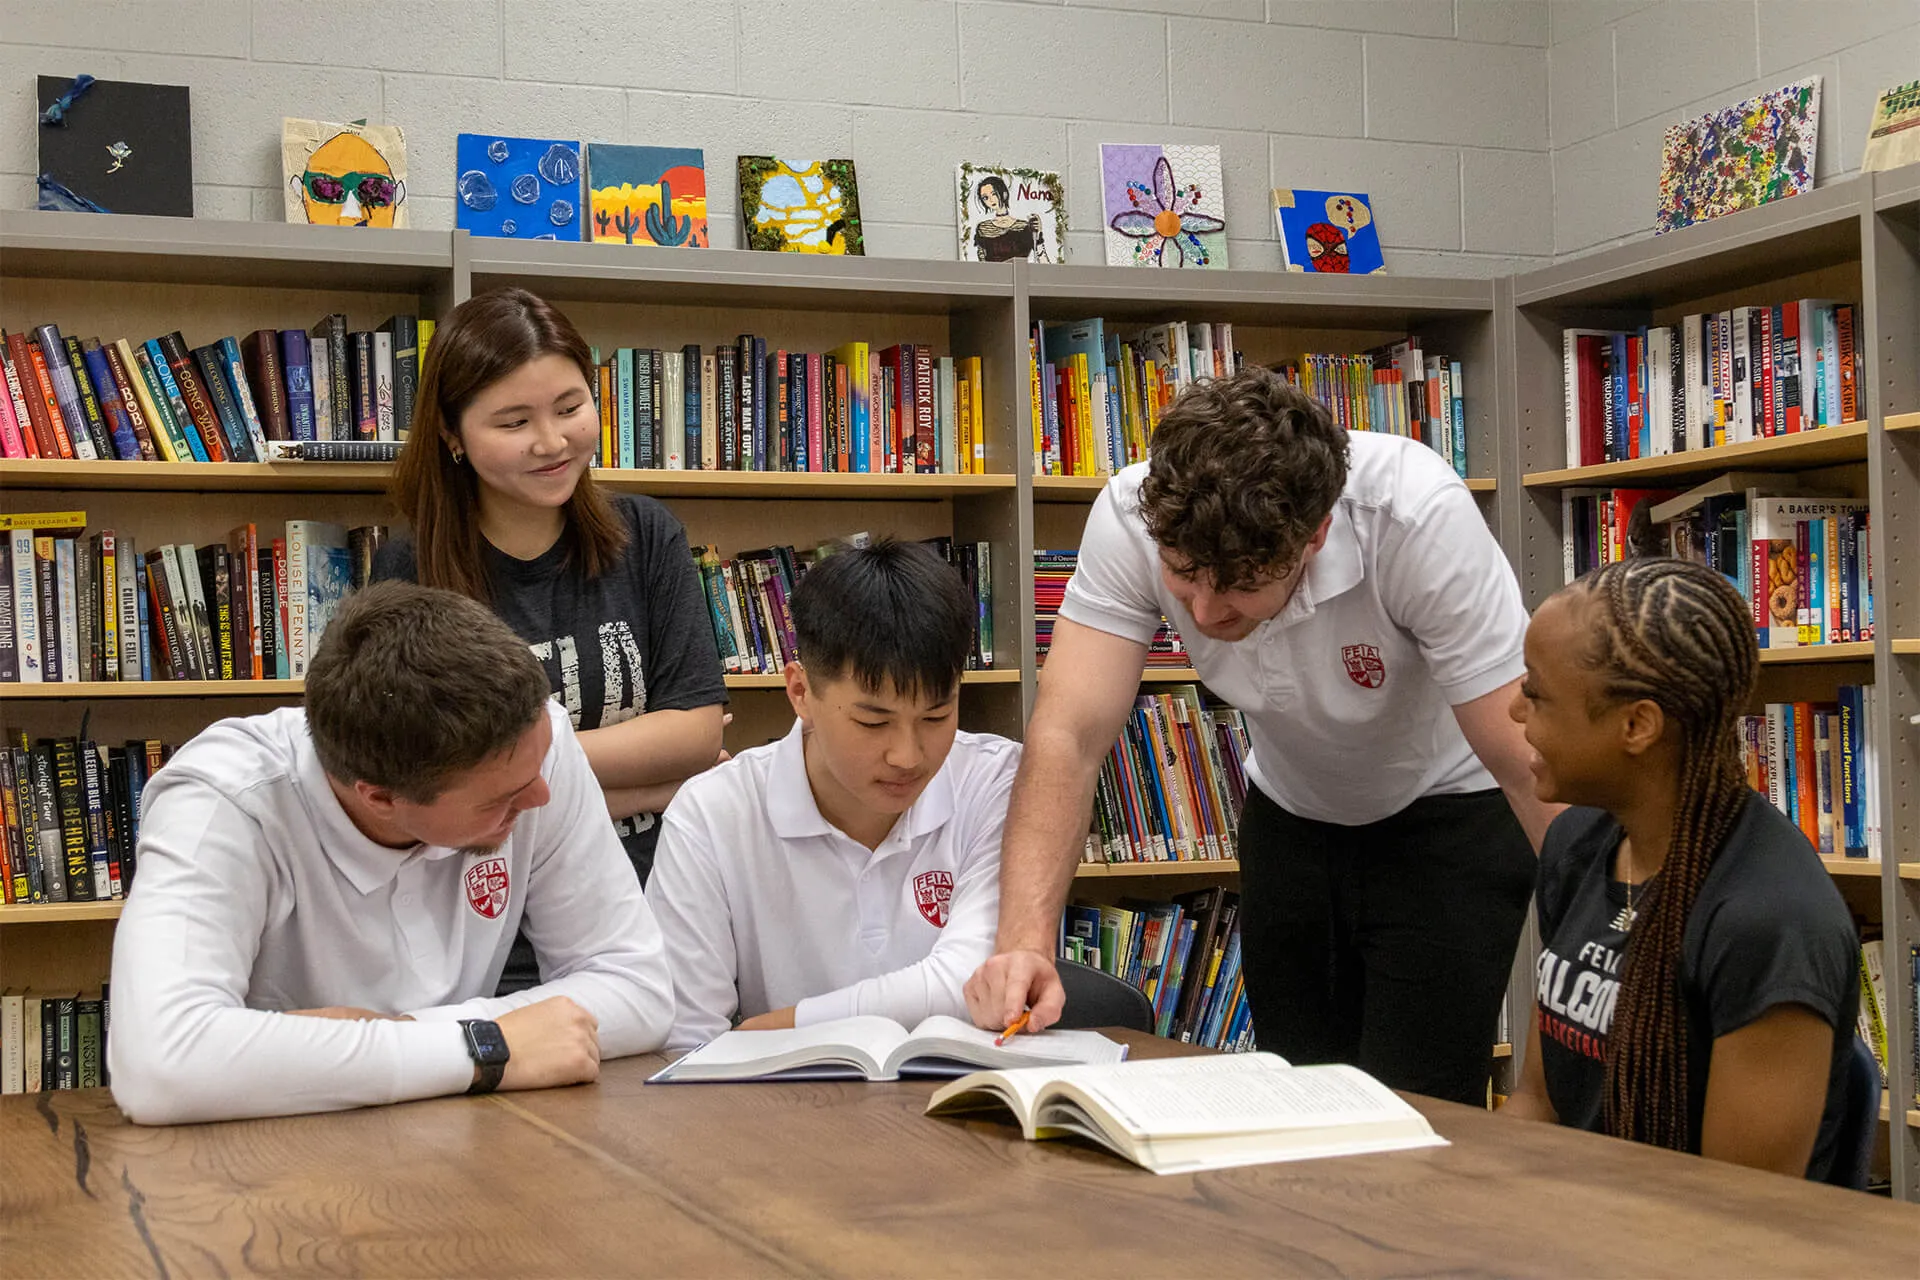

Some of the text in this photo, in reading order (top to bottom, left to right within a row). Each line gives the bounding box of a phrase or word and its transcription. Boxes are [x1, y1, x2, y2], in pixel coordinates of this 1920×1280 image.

[903, 350, 912, 396] AGAINST ALL
[1712, 350, 1720, 388] FATHER
[1720, 319, 1730, 399] FORD NATION
[1752, 336, 1762, 389] PERSUASION
[1762, 333, 1770, 370] ROGERS
[1839, 319, 1853, 414] WHISKY KING
[67, 340, 77, 351] ALL
[85, 397, 98, 422] TODAYS
[153, 353, 178, 397] GONE
[206, 361, 228, 404] BLOODING
[266, 353, 280, 414] VIKING WARRIOR
[795, 375, 803, 410] Language
[917, 357, 932, 429] PATRICK ROY
[1773, 332, 1784, 431] LLOYD ROBERTSON
[10, 399, 31, 429] MURDER
[120, 386, 143, 426] BOB
[158, 397, 178, 436] EXTINCTION
[180, 370, 219, 446] GOING WILD
[378, 375, 394, 431] 26 Kisses
[622, 378, 630, 419] SWIMMING
[639, 354, 652, 461] INGER ASH WOLFE THE NIGHT BELL
[723, 366, 733, 462] LIGHTNING CATCHER
[742, 375, 752, 457] LAST MAN OUT
[1604, 374, 1613, 446] TRUDEAUMANIA
[1777, 505, 1785, 514] A
[1789, 504, 1837, 514] BAKER'S
[16, 539, 31, 554] 99
[42, 560, 50, 572] TWO
[18, 567, 35, 640] WAYNE GRETZKY
[105, 565, 113, 603] ALMANAC
[277, 559, 288, 608] DOUBLE
[291, 531, 304, 658] LOUISE PENNY
[1810, 566, 1818, 600] Sisters
[122, 587, 137, 664] CHILDREN OF EXILE
[218, 604, 230, 621] THIS
[261, 572, 274, 656] EMPIRE NIGHT
[47, 648, 55, 661] TELL
[163, 612, 182, 668] KENNETH OPPEL
[221, 632, 231, 649] HOW
[221, 650, 232, 658] IT
[1345, 646, 1377, 659] FEIA
[48, 661, 56, 673] YOU
[1768, 718, 1777, 757] HALIFAX
[1842, 705, 1853, 804] Advanced Functions
[34, 754, 53, 822] starlight tour
[56, 742, 77, 788] PETER
[84, 748, 100, 811] BLEEDING BLUE
[19, 778, 37, 858] BOYS BOAT
[63, 807, 88, 876] BEHRENS
[468, 861, 502, 886] FEIA
[917, 873, 949, 890] FEIA
